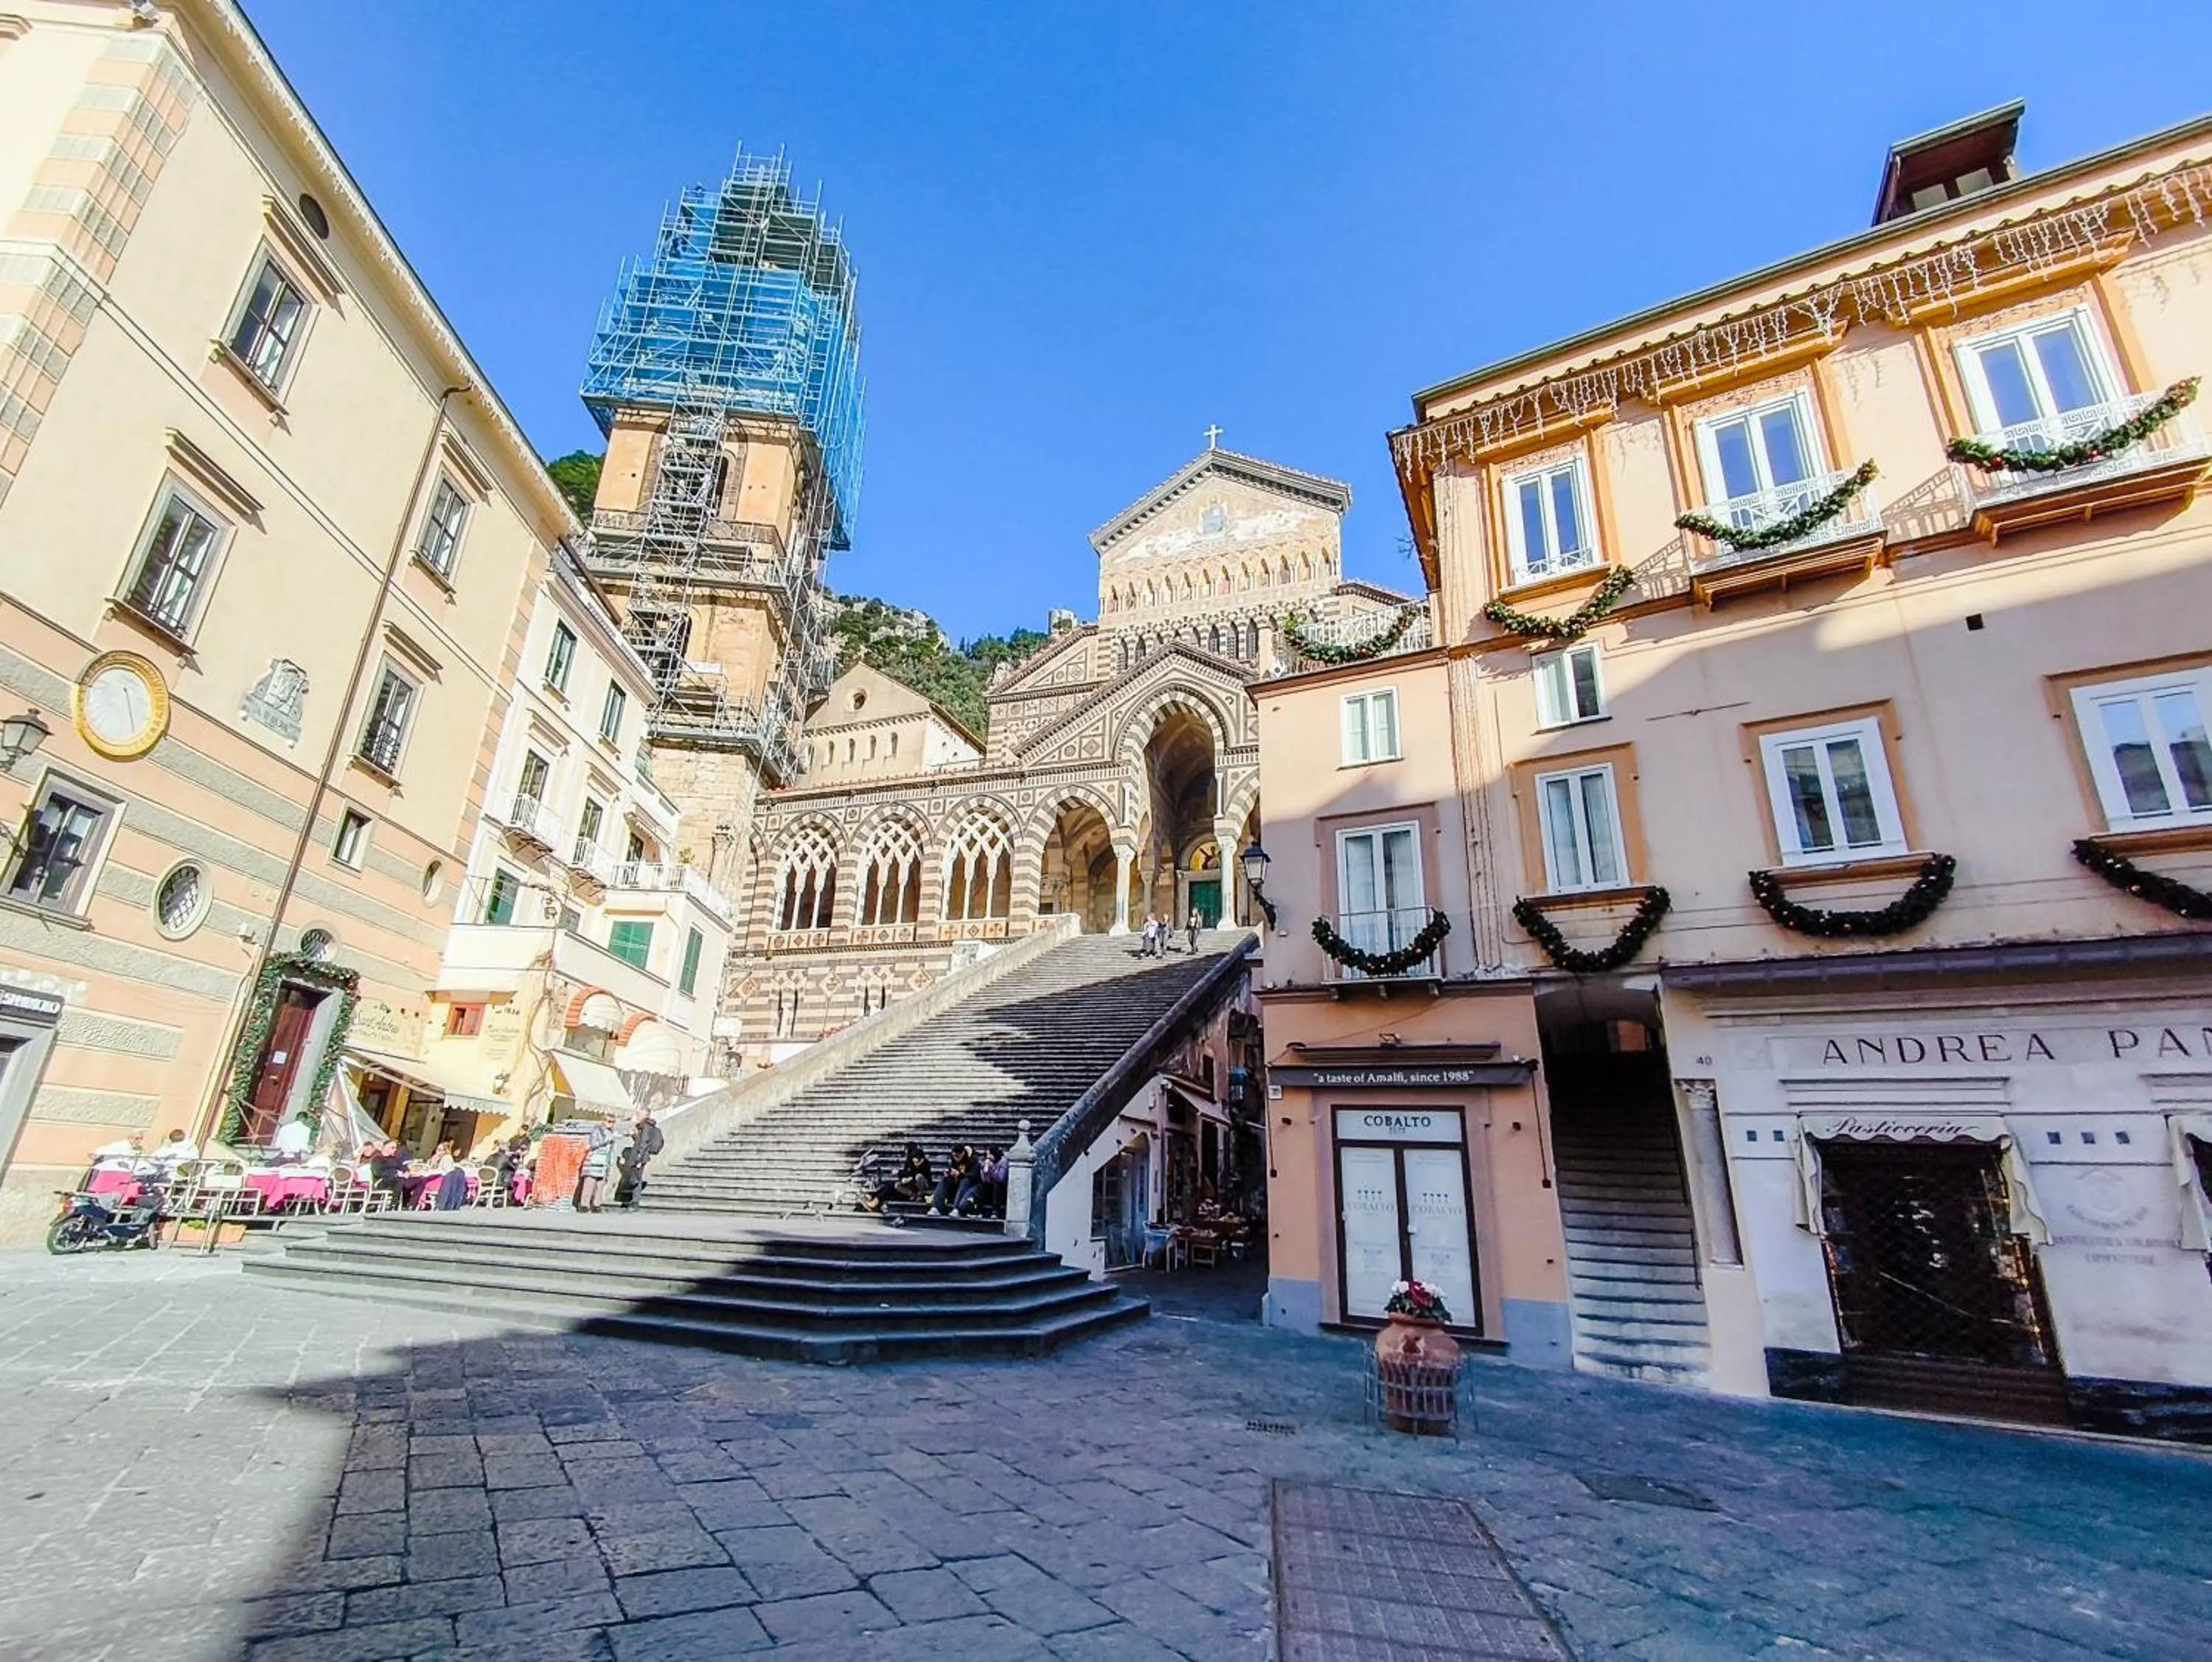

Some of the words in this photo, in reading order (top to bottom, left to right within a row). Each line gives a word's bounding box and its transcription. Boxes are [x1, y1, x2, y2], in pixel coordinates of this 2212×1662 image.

[1822, 1033, 2056, 1065] ANDREA
[1696, 1055, 1712, 1066] 40
[1326, 1073, 1352, 1084] taste
[1353, 1073, 1365, 1083] of
[1367, 1071, 1408, 1084] Amalfi,
[1410, 1071, 1440, 1082] since
[1363, 1114, 1432, 1128] COBALTO
[1826, 1116, 1980, 1134] Pasticceria
